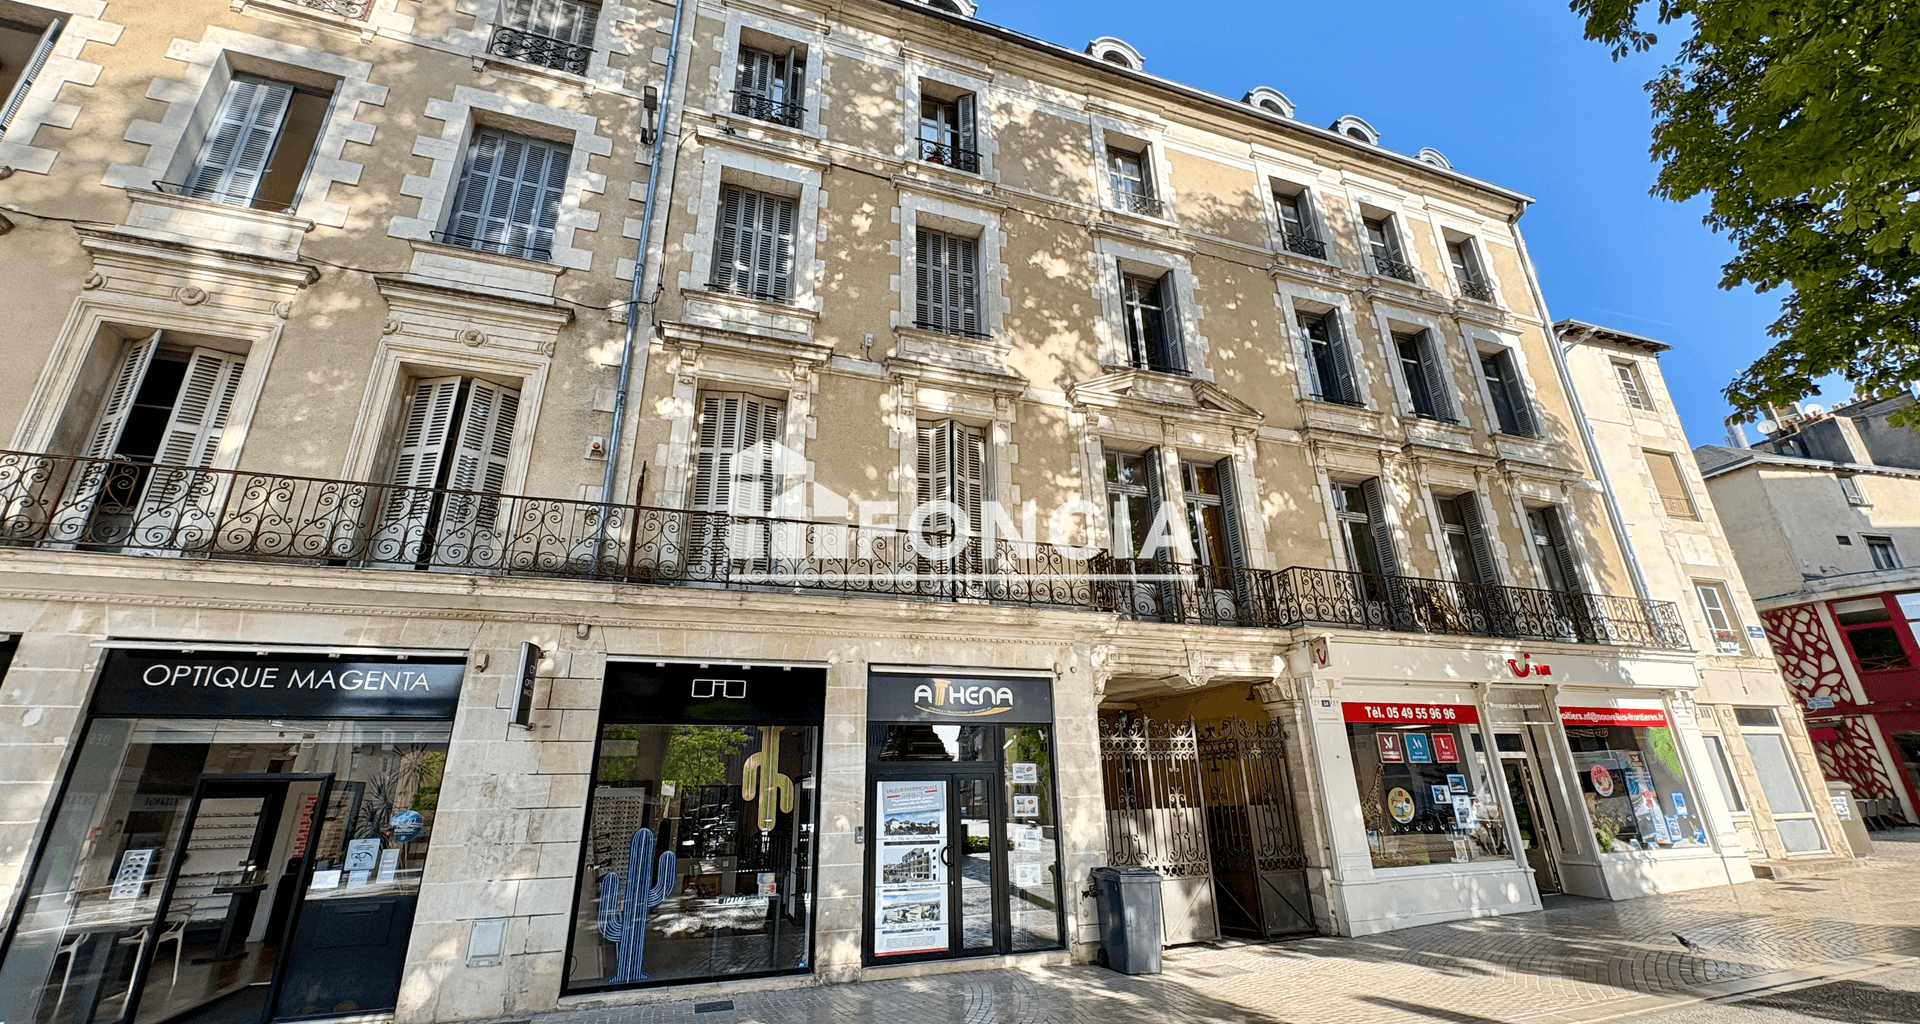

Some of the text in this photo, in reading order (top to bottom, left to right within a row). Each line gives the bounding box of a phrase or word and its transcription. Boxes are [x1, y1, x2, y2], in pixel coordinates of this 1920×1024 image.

[142, 664, 430, 691] OPTIQUE MAGENTA
[914, 678, 1014, 706] ATHENA
[1364, 706, 1456, 720] Tél. 05 49 55 96 96
